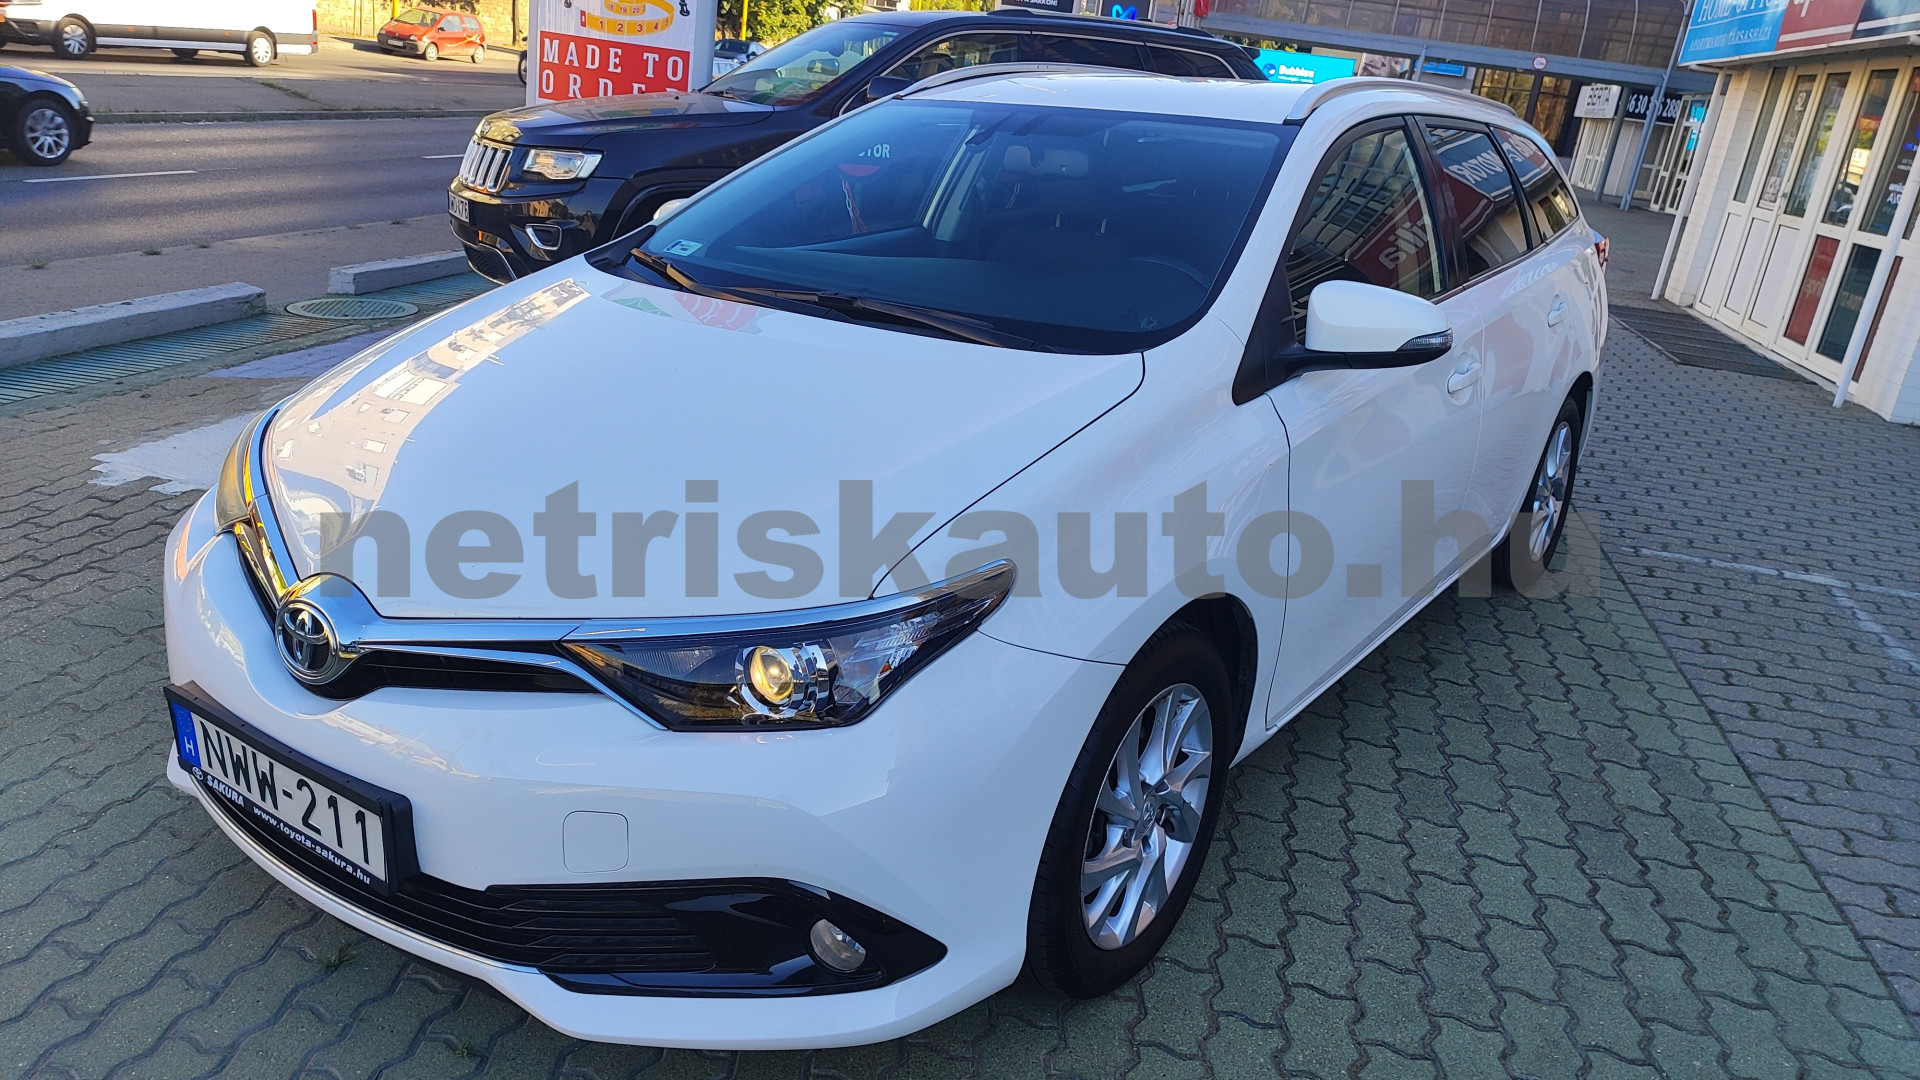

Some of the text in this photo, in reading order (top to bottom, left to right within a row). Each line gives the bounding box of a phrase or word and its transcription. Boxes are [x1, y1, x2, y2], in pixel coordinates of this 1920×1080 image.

[599, 20, 604, 30] 1
[617, 22, 624, 32] 2
[637, 23, 643, 33] 3
[653, 22, 659, 31] 4
[543, 37, 684, 82] MADE TO
[541, 69, 680, 99] ORD
[184, 736, 196, 758] H
[200, 719, 370, 866] NWW-211
[206, 774, 371, 885] SAKURA www.toyota-sakura.hu
